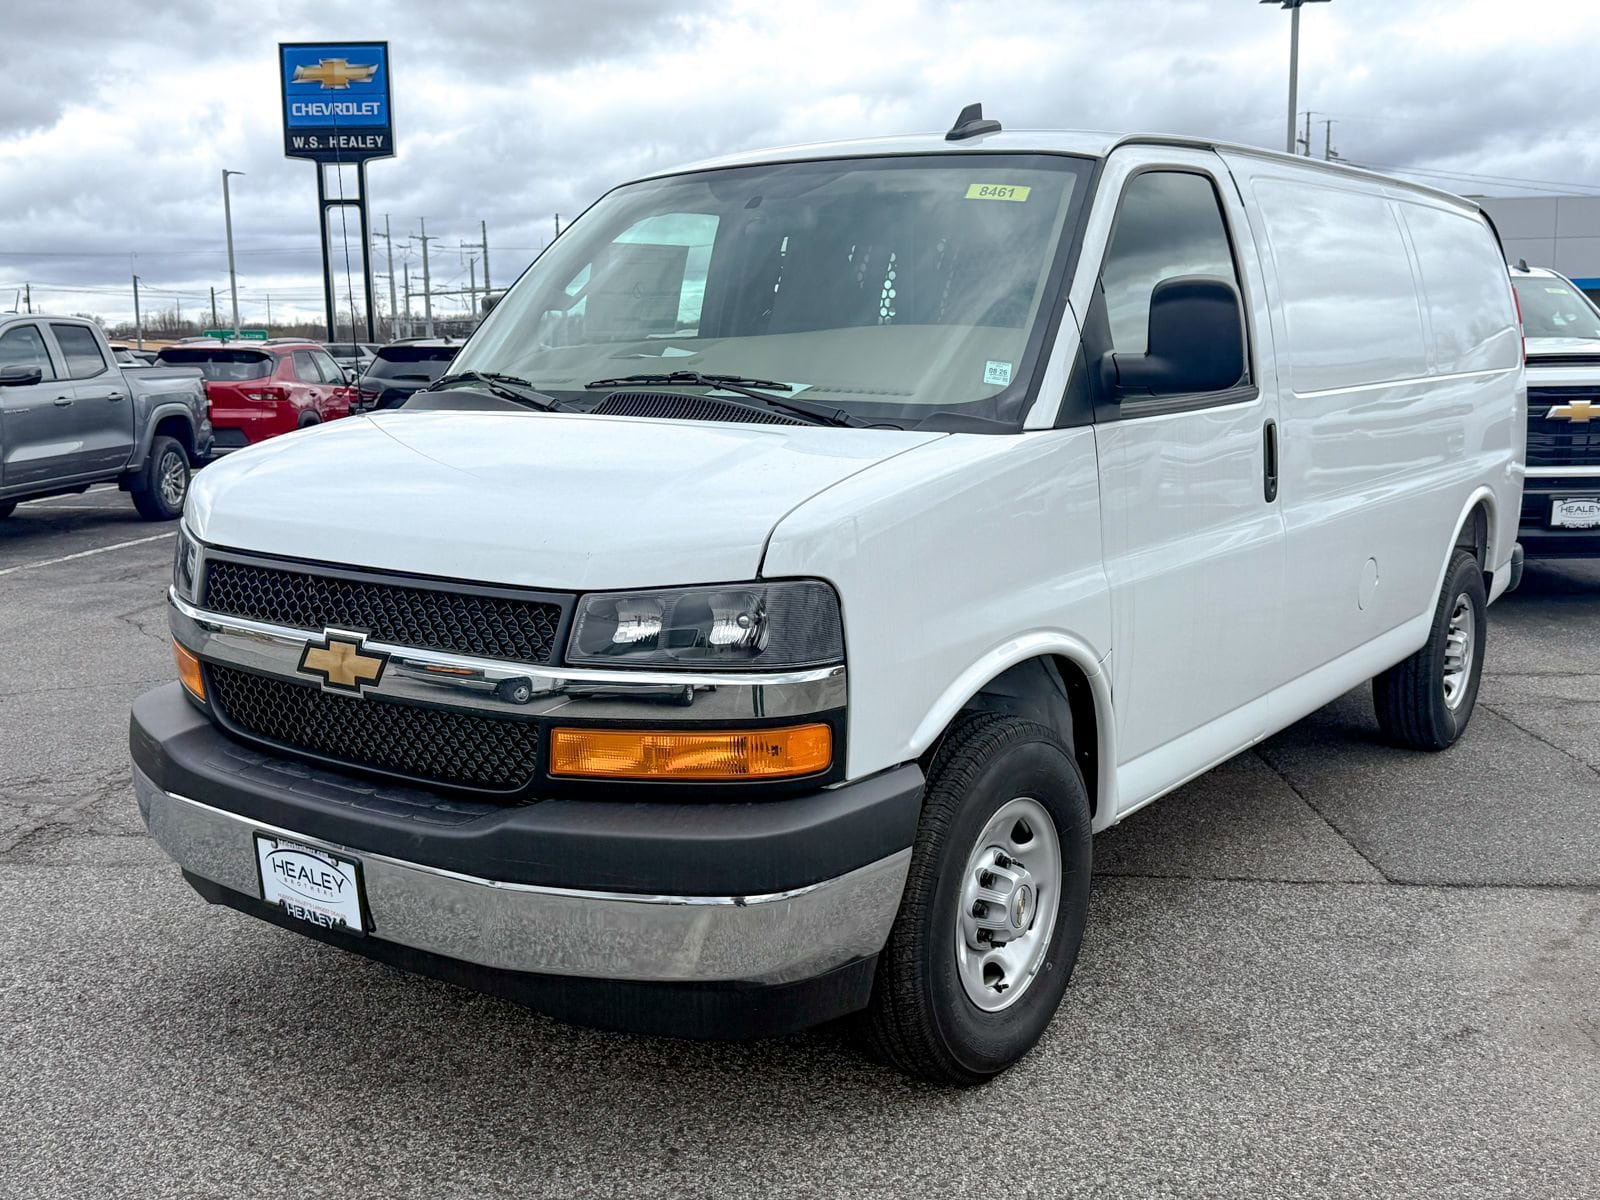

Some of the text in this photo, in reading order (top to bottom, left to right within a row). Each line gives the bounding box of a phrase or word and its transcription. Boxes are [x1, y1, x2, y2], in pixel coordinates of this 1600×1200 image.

[292, 102, 380, 116] CHEVROLET
[292, 135, 384, 149] W.S. HEALEY
[979, 186, 1016, 199] 8461
[272, 857, 344, 893] HEALEY
[284, 877, 334, 898] BROTHERS
[286, 903, 335, 929] HEALEY
